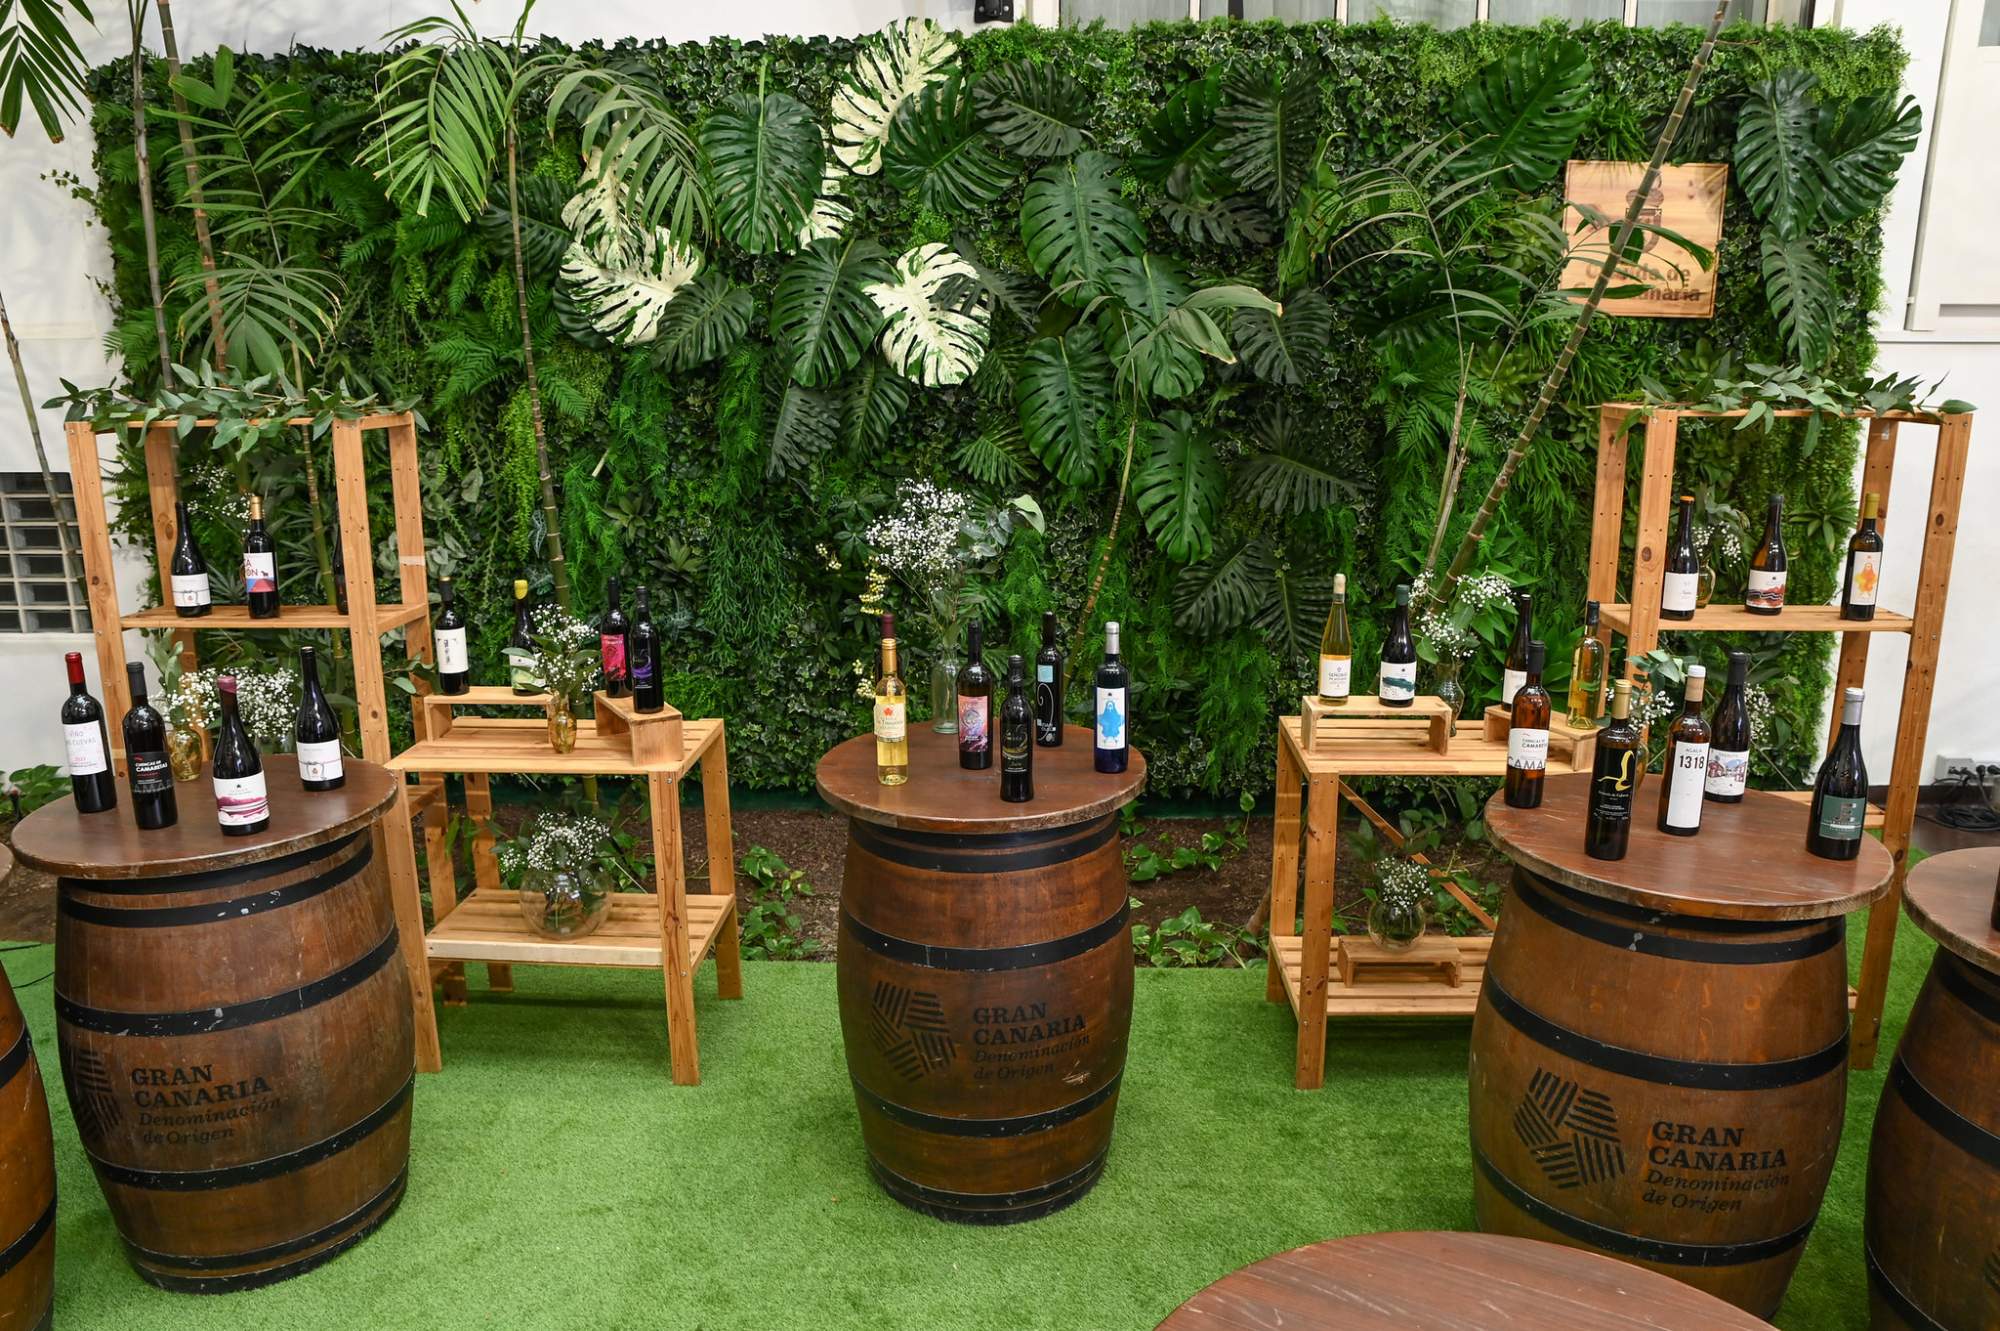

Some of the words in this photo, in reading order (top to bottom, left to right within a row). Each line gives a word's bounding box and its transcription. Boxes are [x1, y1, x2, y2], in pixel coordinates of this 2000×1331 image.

[1679, 755, 1705, 769] 1318
[973, 1002, 1047, 1025] GRAN
[973, 1014, 1087, 1045] CANARIA
[131, 1064, 213, 1086] GRAN
[973, 1066, 993, 1081] de
[997, 1063, 1055, 1081] Origen
[134, 1077, 271, 1108] CANARIA
[143, 1130, 164, 1145] de
[166, 1128, 235, 1146] Origen
[1652, 1121, 1745, 1148] GRAN
[1649, 1146, 1788, 1171] CANARIA
[1642, 1188, 1667, 1206] de
[1671, 1192, 1743, 1213] Origen
